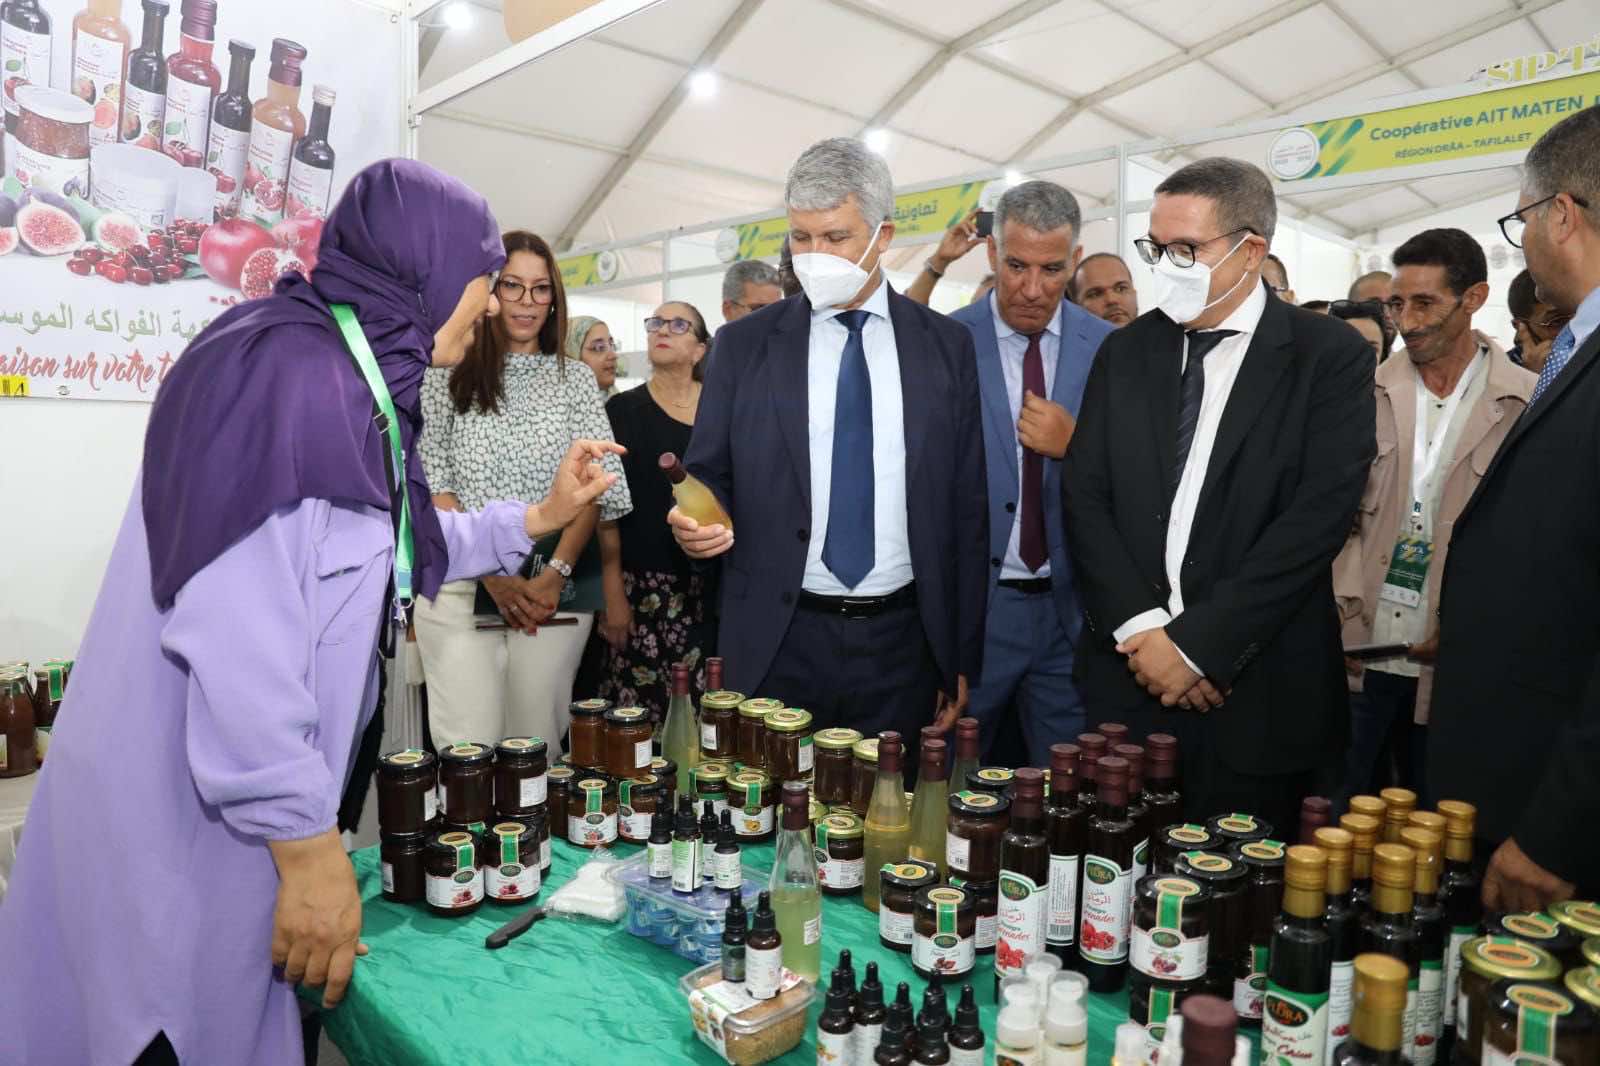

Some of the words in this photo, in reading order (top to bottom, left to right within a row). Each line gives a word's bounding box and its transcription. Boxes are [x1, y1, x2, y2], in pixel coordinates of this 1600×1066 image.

[1370, 114, 1473, 140] Coopérative
[1476, 107, 1508, 125] AIT
[1511, 96, 1583, 120] MATEN
[1473, 132, 1531, 149] TAFILALET
[84, 306, 161, 342] الفواكه
[63, 351, 101, 391] sur
[103, 348, 156, 392] votre
